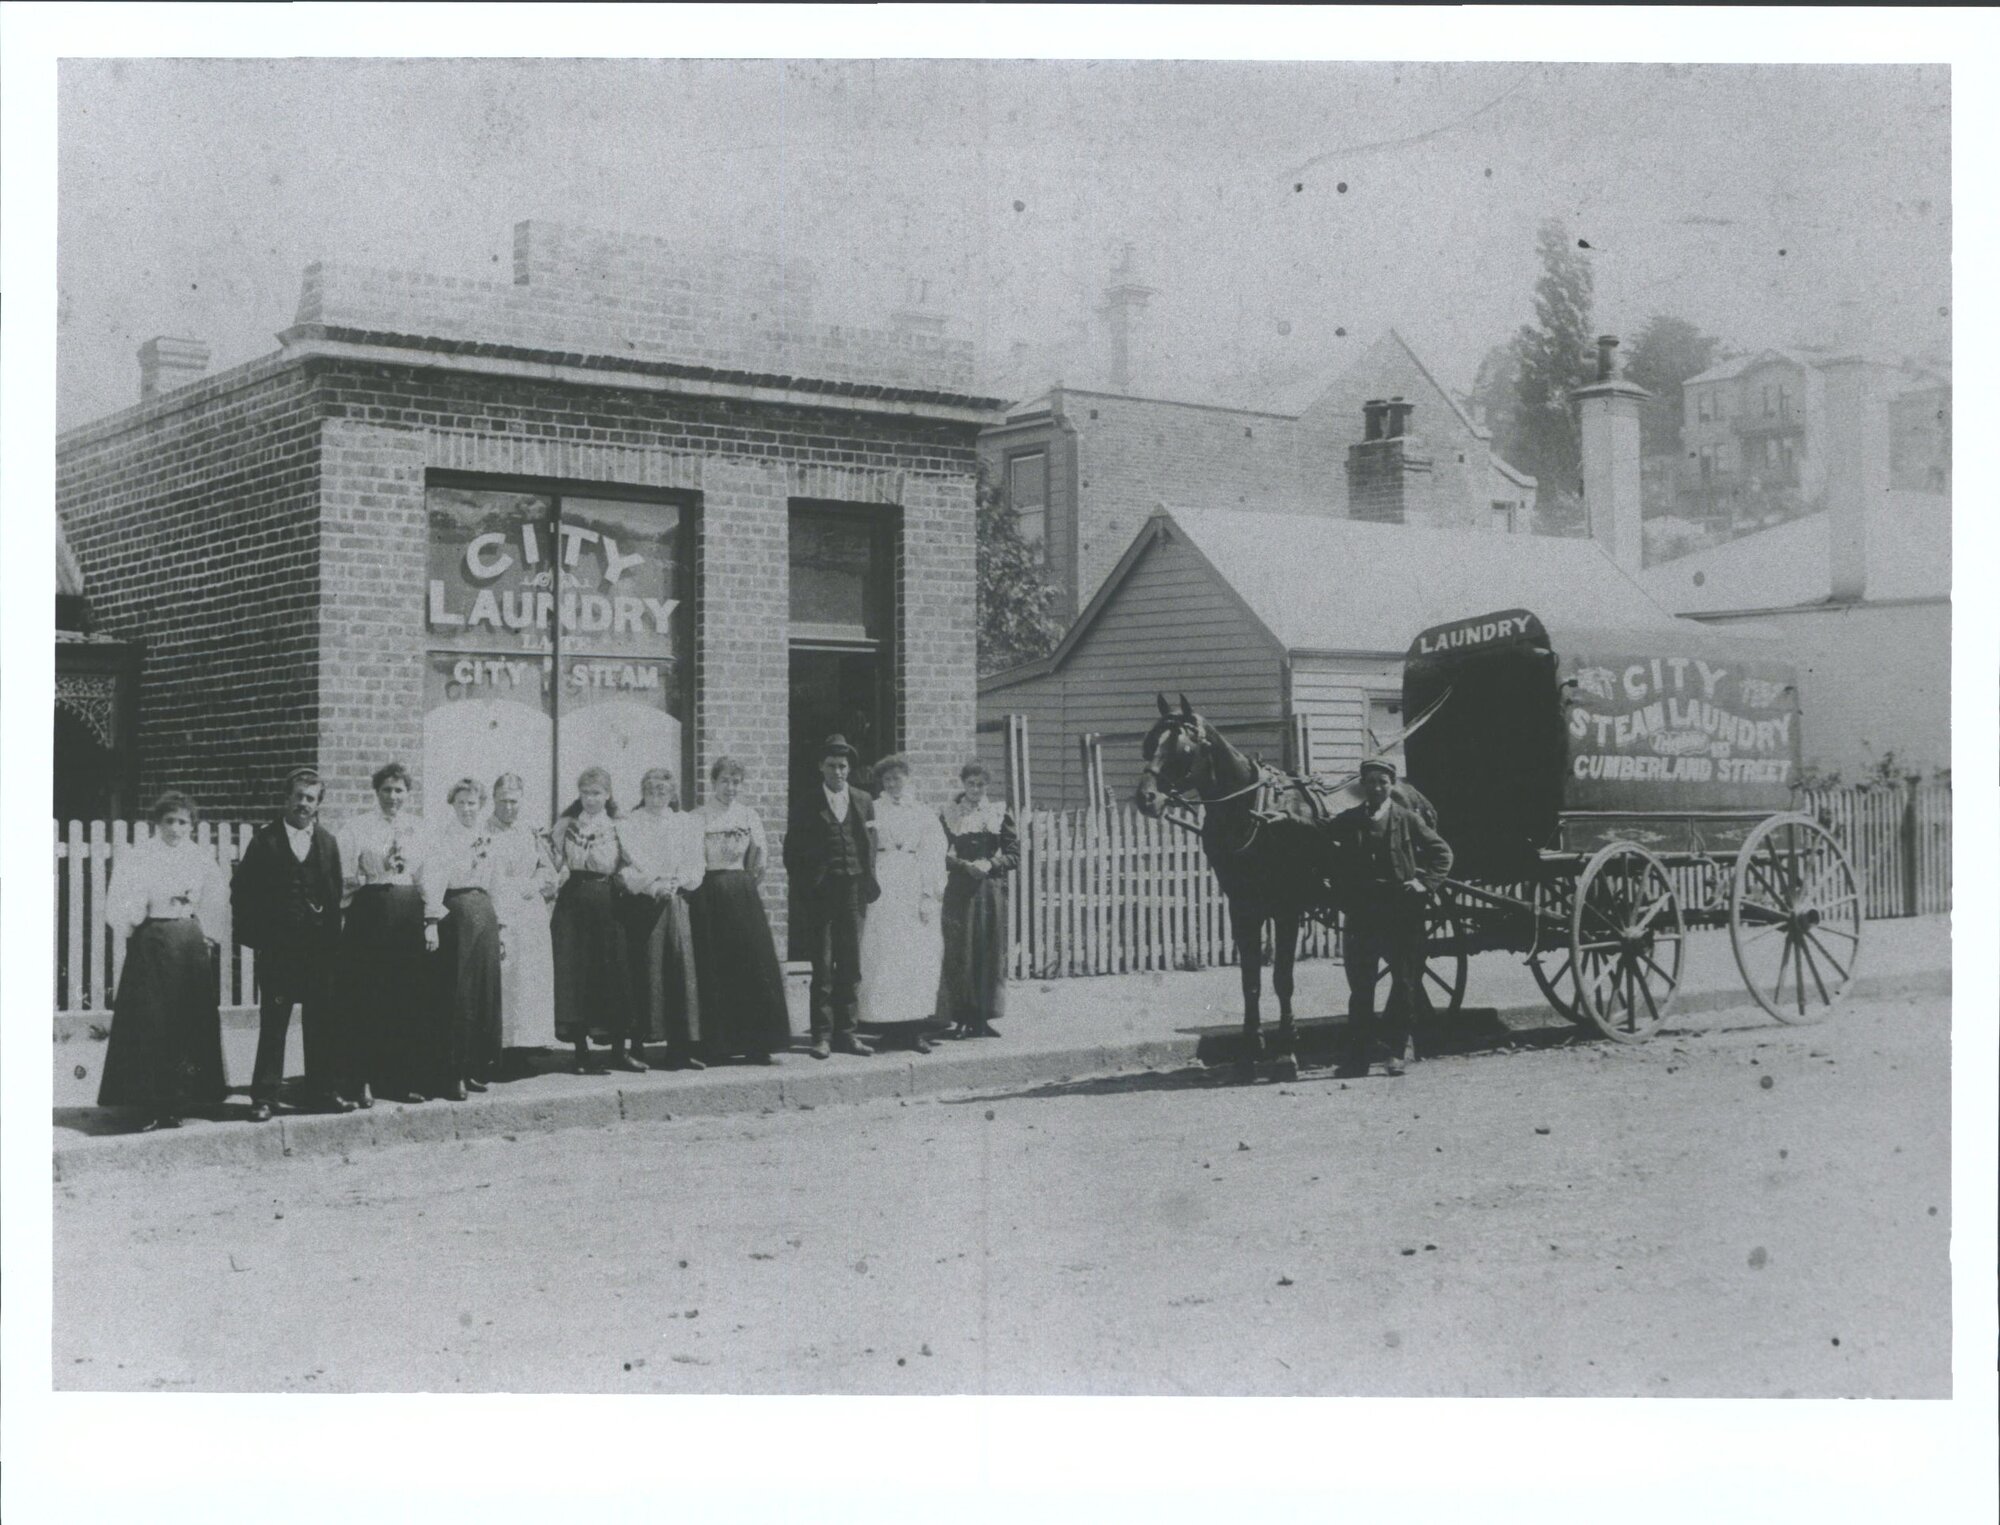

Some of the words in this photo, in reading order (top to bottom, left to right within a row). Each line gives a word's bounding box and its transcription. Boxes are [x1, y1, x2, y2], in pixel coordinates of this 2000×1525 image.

[466, 522, 646, 584] CITY
[429, 579, 681, 634] LAUNDRY
[1420, 614, 1531, 654] LAUNDRY
[454, 660, 528, 686] CITY
[572, 664, 659, 688] STEAM
[1623, 657, 1727, 698] CITY
[1569, 701, 1666, 747] STEAM
[1668, 697, 1792, 751] LAUNDRY
[1574, 754, 1712, 782] CUMBERLAND
[1717, 759, 1792, 783] STREET
